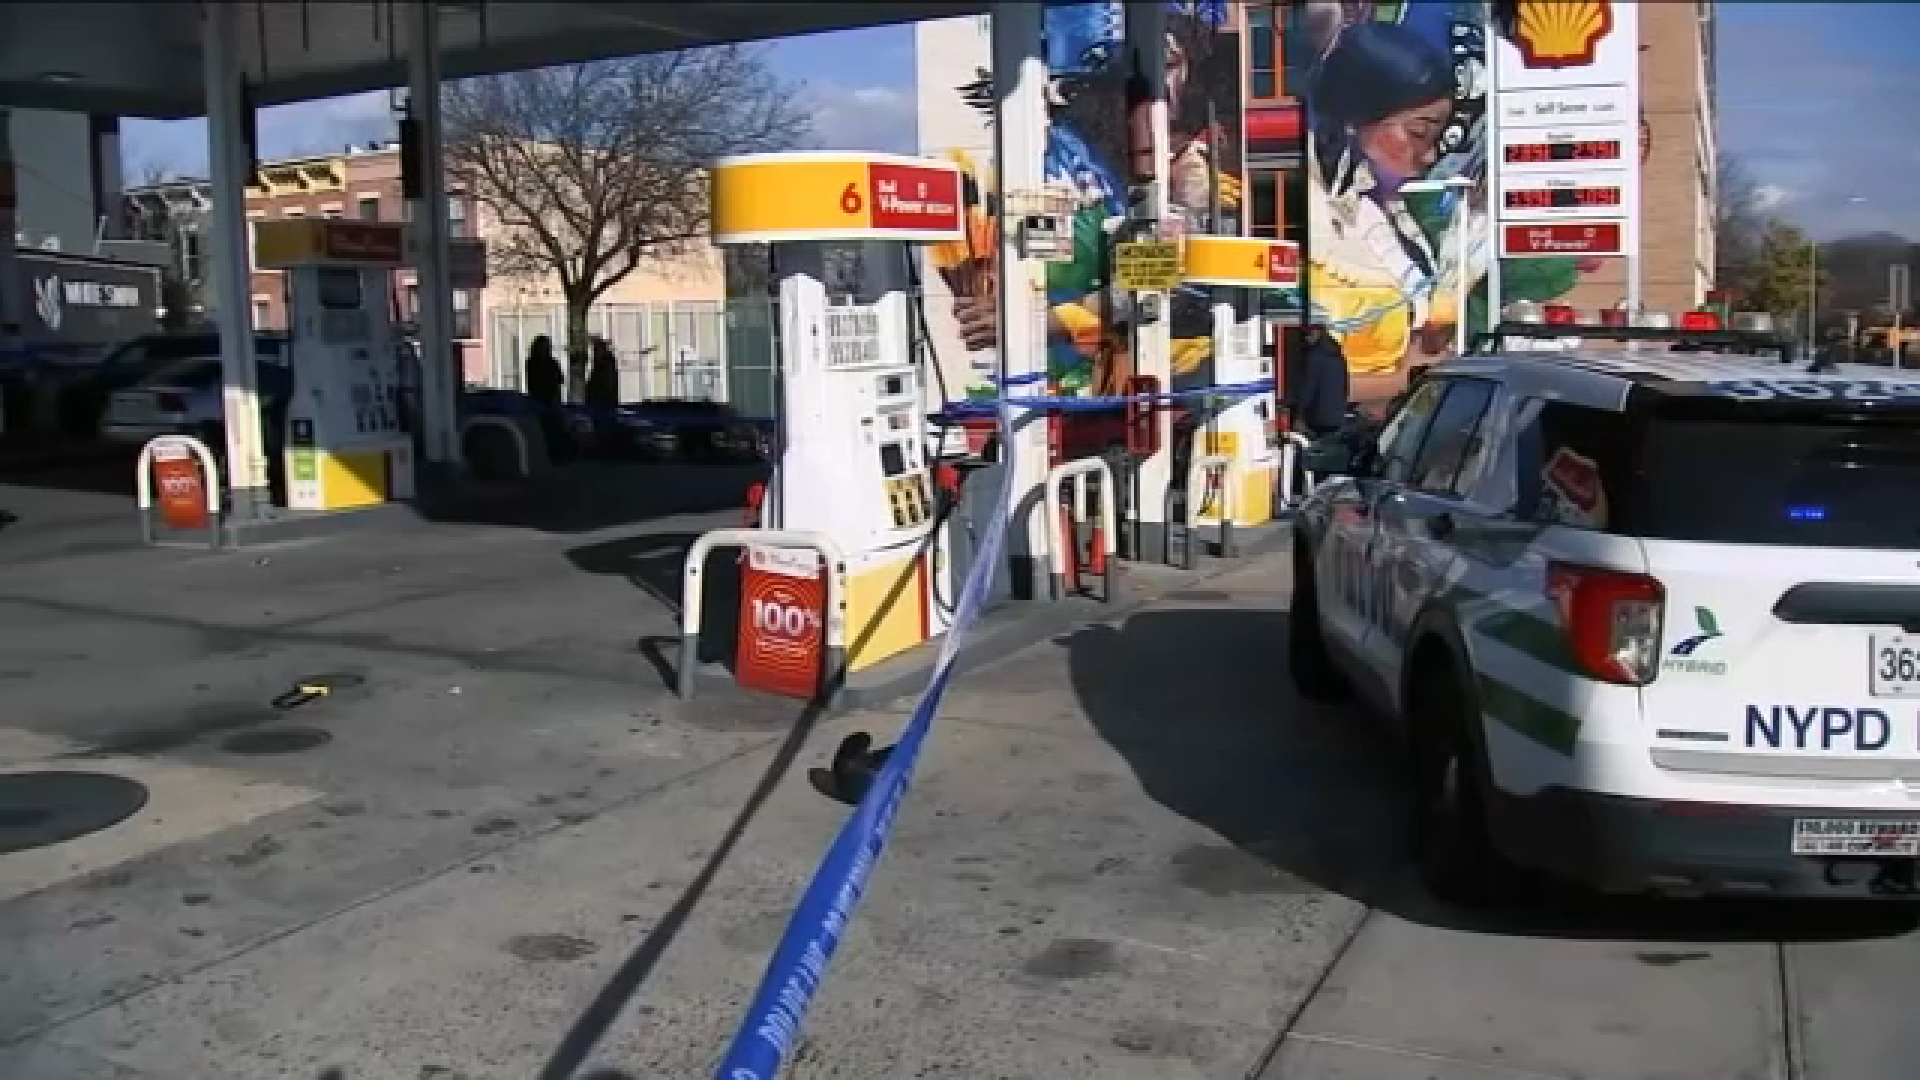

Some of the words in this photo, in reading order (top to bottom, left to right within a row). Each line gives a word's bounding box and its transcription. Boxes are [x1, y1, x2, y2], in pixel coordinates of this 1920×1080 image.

[841, 182, 861, 213] 6
[1254, 252, 1264, 270] 4
[1661, 659, 1728, 675] HYBRID
[1880, 648, 1920, 681] 36
[1745, 704, 1891, 750] NYPD
